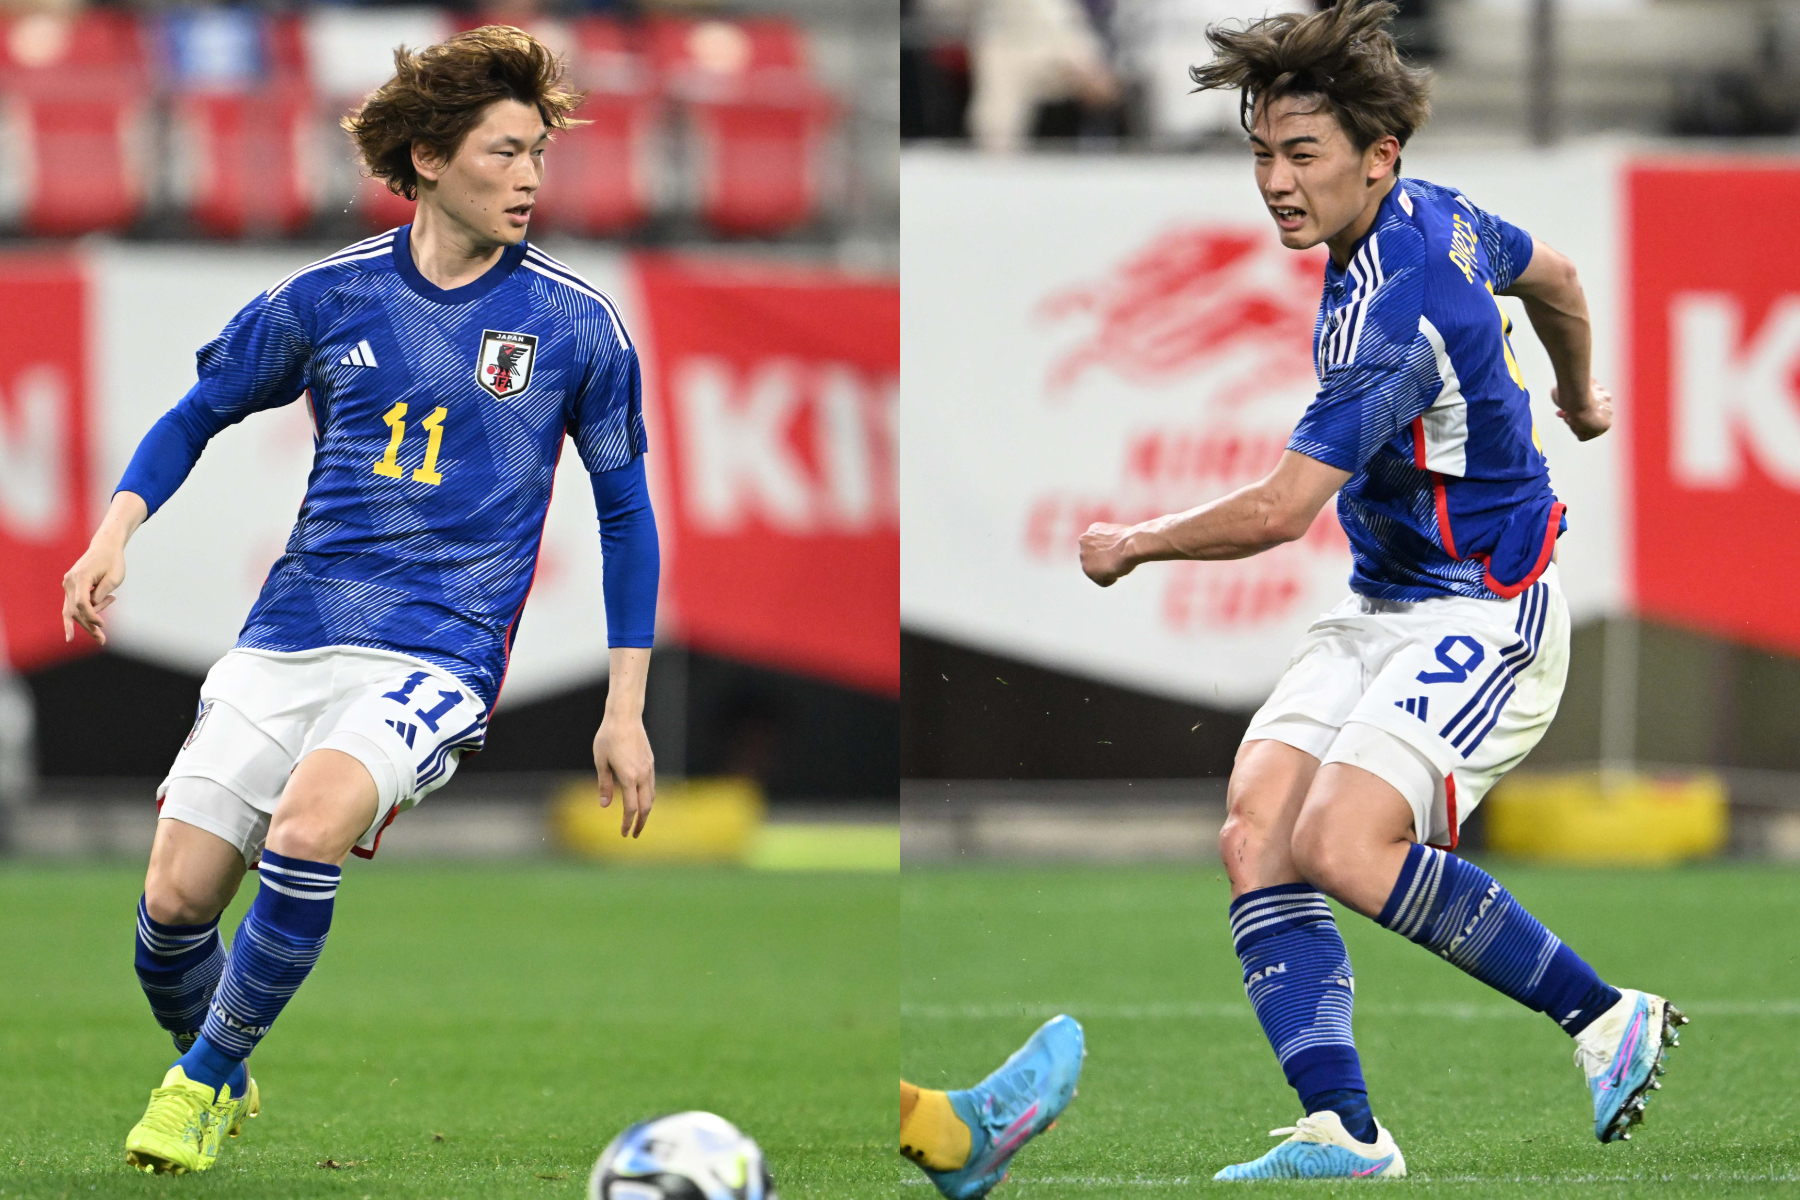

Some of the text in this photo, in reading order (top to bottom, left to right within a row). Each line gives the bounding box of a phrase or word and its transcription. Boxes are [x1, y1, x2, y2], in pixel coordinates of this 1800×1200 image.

[496, 334, 524, 342] JAPAN
[489, 376, 513, 389] JFA
[373, 402, 448, 486] 11
[680, 358, 900, 530] KI
[1415, 635, 1485, 684] 9
[381, 671, 464, 734] 11
[210, 1002, 270, 1036] JAPAN
